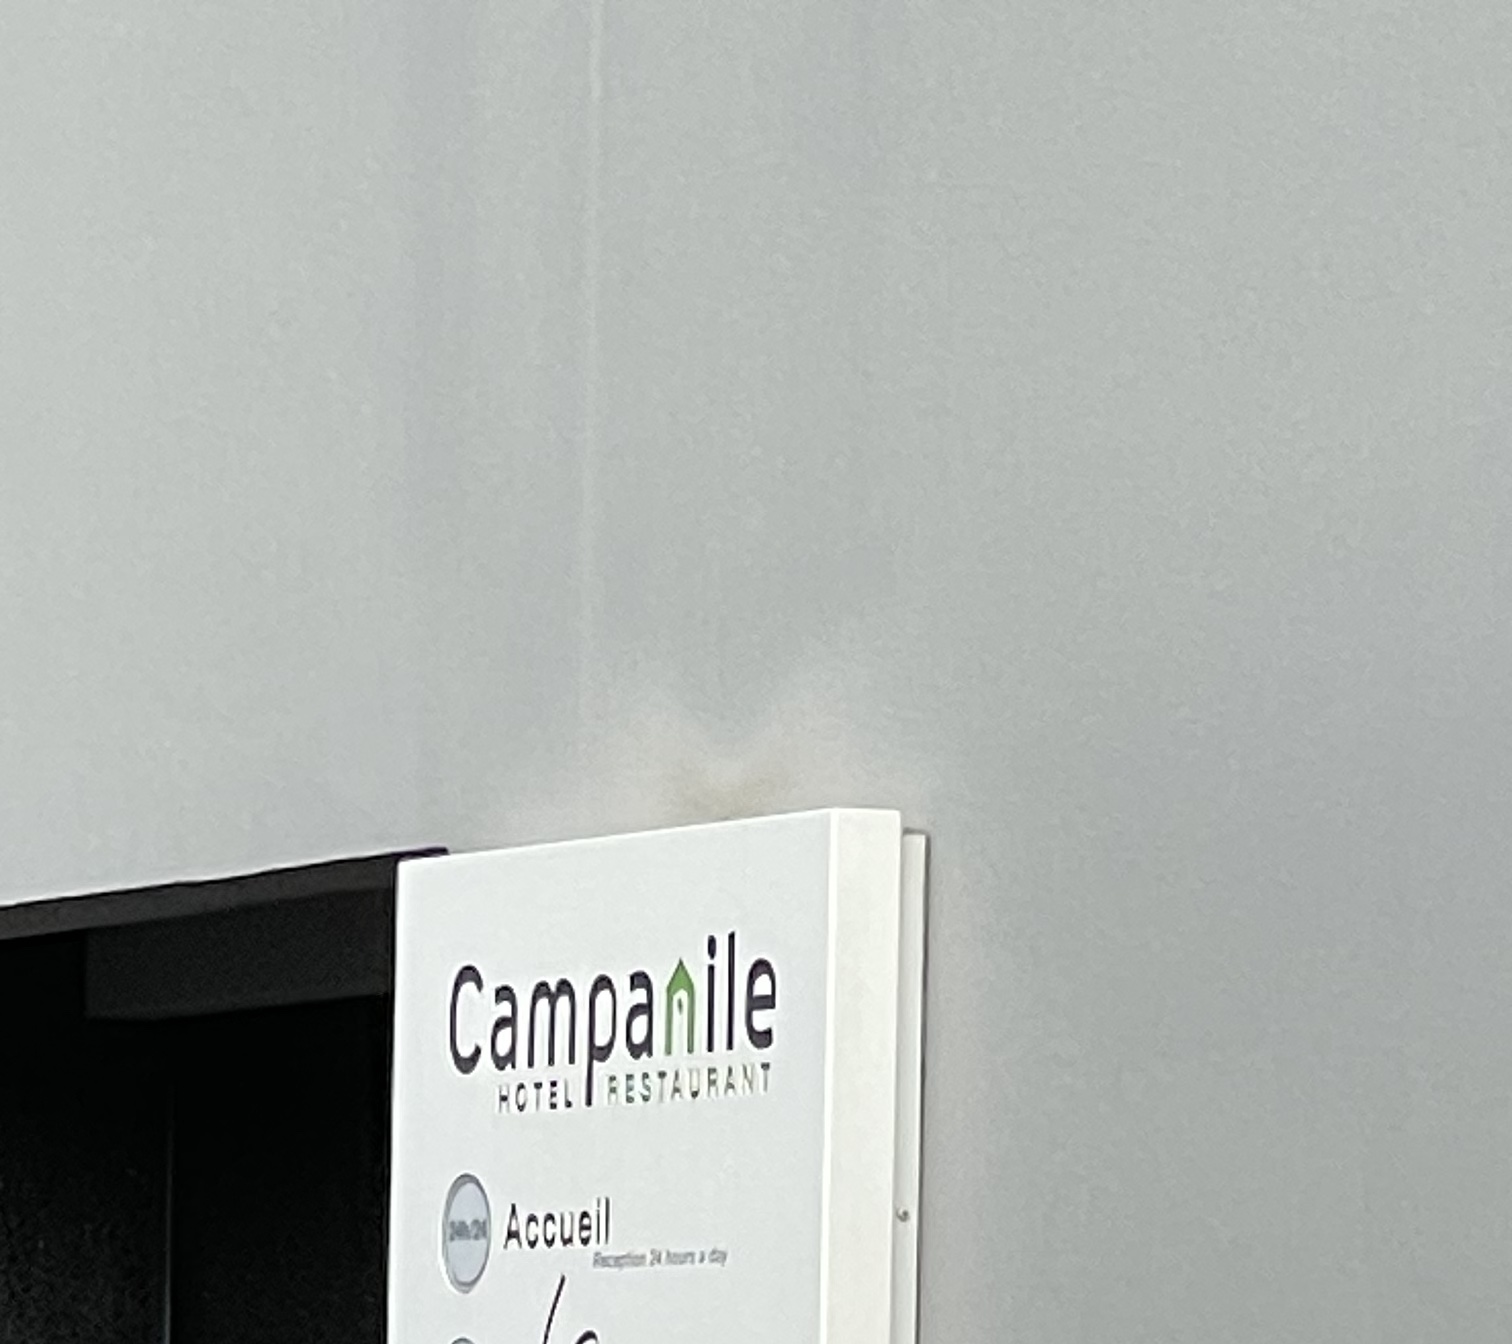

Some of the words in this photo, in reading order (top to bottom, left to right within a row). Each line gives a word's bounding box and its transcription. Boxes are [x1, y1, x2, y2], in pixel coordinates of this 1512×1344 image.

[450, 931, 776, 1107] Campanile
[497, 1079, 573, 1114] HOTEL
[607, 1062, 771, 1105] RESTAURANT
[503, 1197, 611, 1250] Accueil
[650, 1248, 662, 1266] 24
[665, 1249, 696, 1265] hours
[709, 1247, 727, 1267] day
